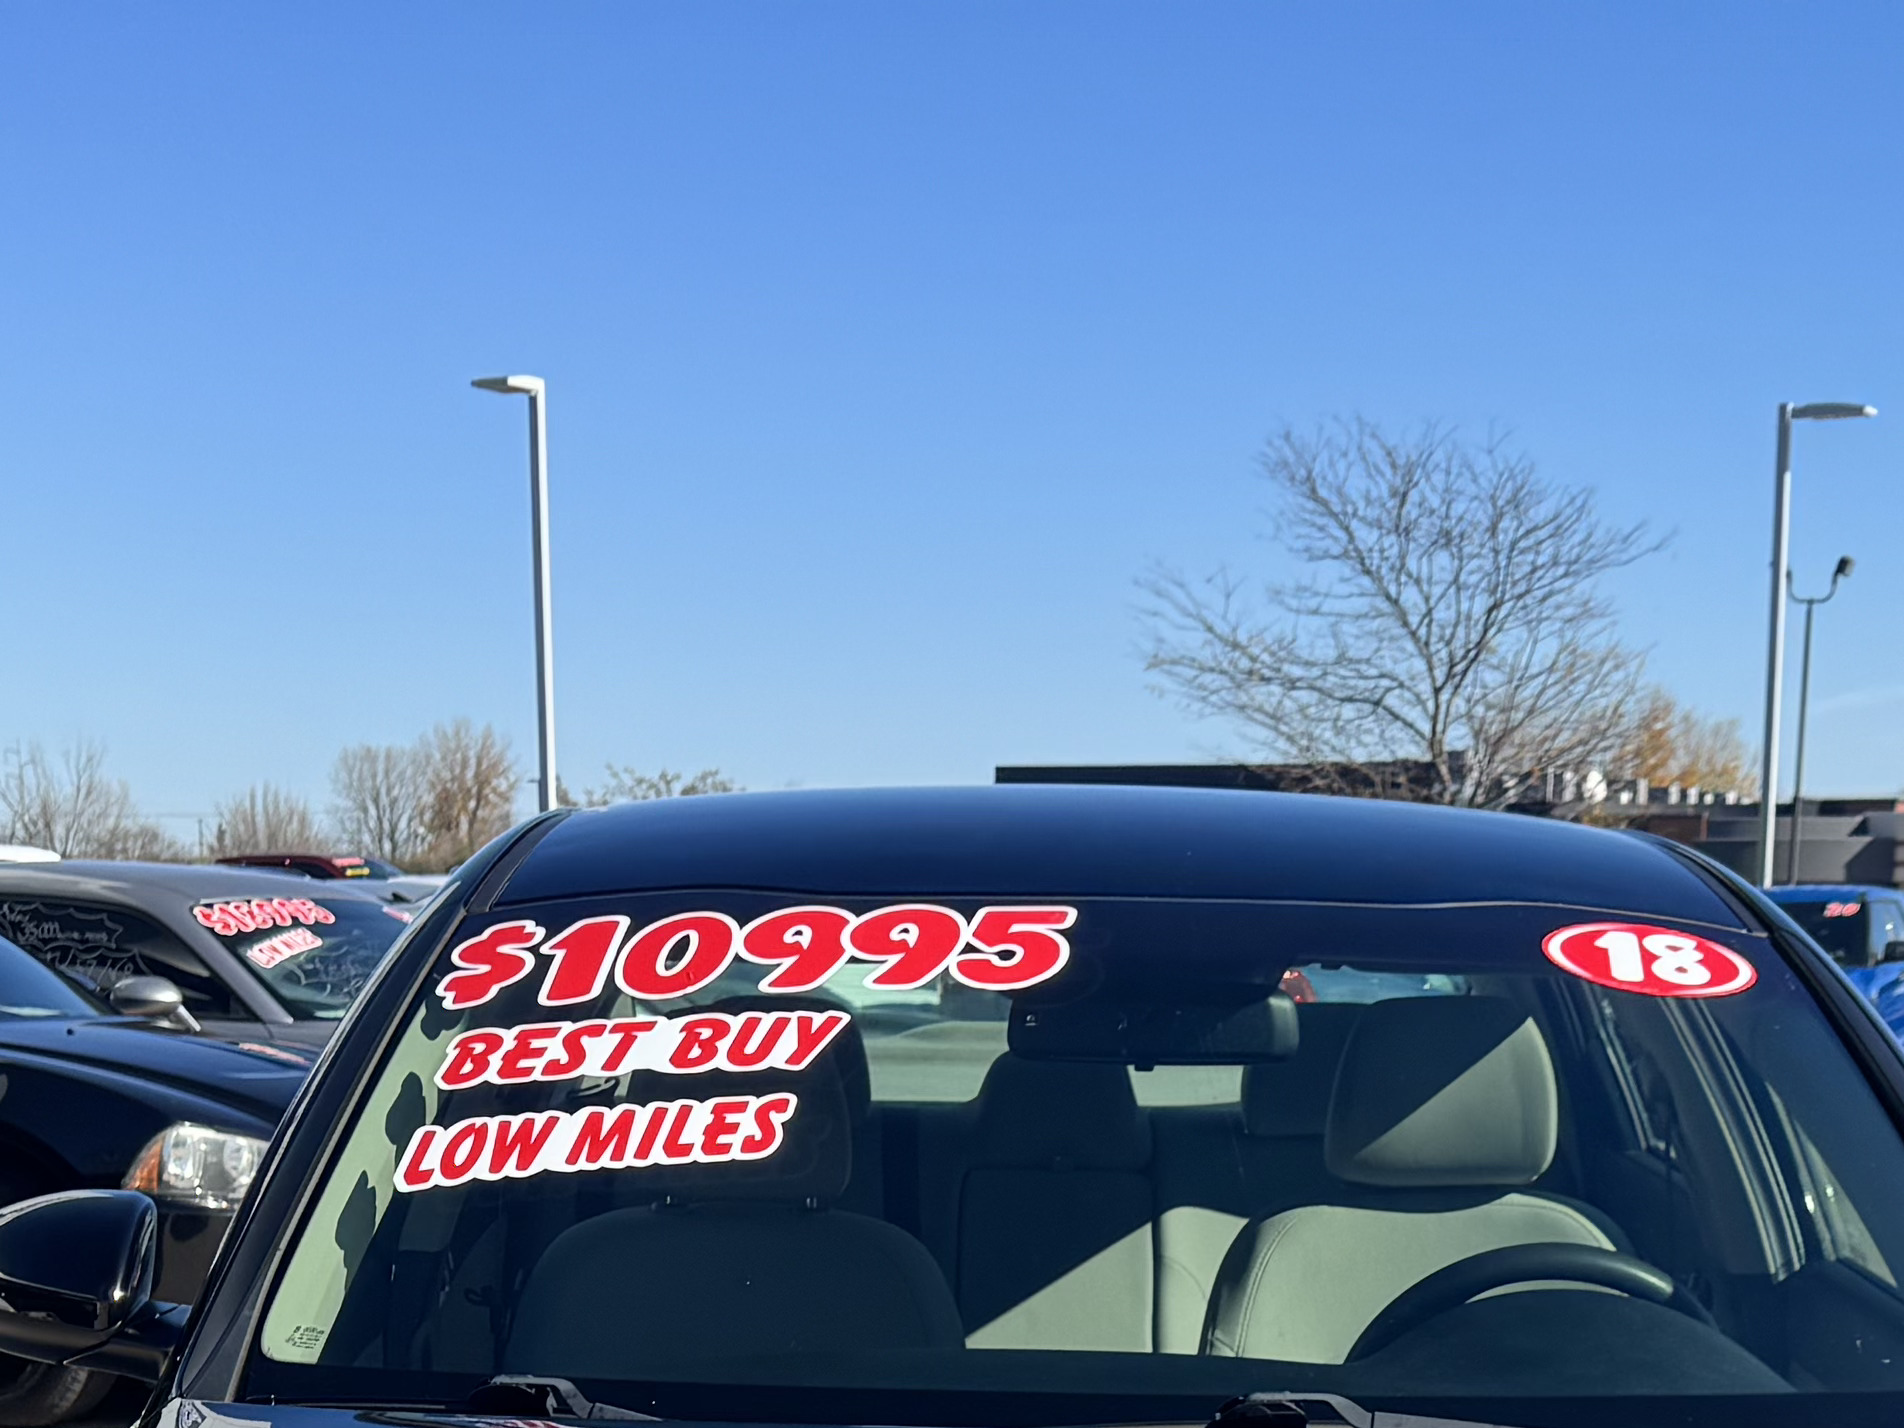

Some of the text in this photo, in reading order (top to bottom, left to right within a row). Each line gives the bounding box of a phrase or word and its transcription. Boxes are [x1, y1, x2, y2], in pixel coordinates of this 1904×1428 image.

[436, 903, 1078, 1010] $10995
[1593, 930, 1712, 986] 18
[439, 1014, 847, 1086] BEST BUY
[402, 1096, 790, 1186] LOW MILES
